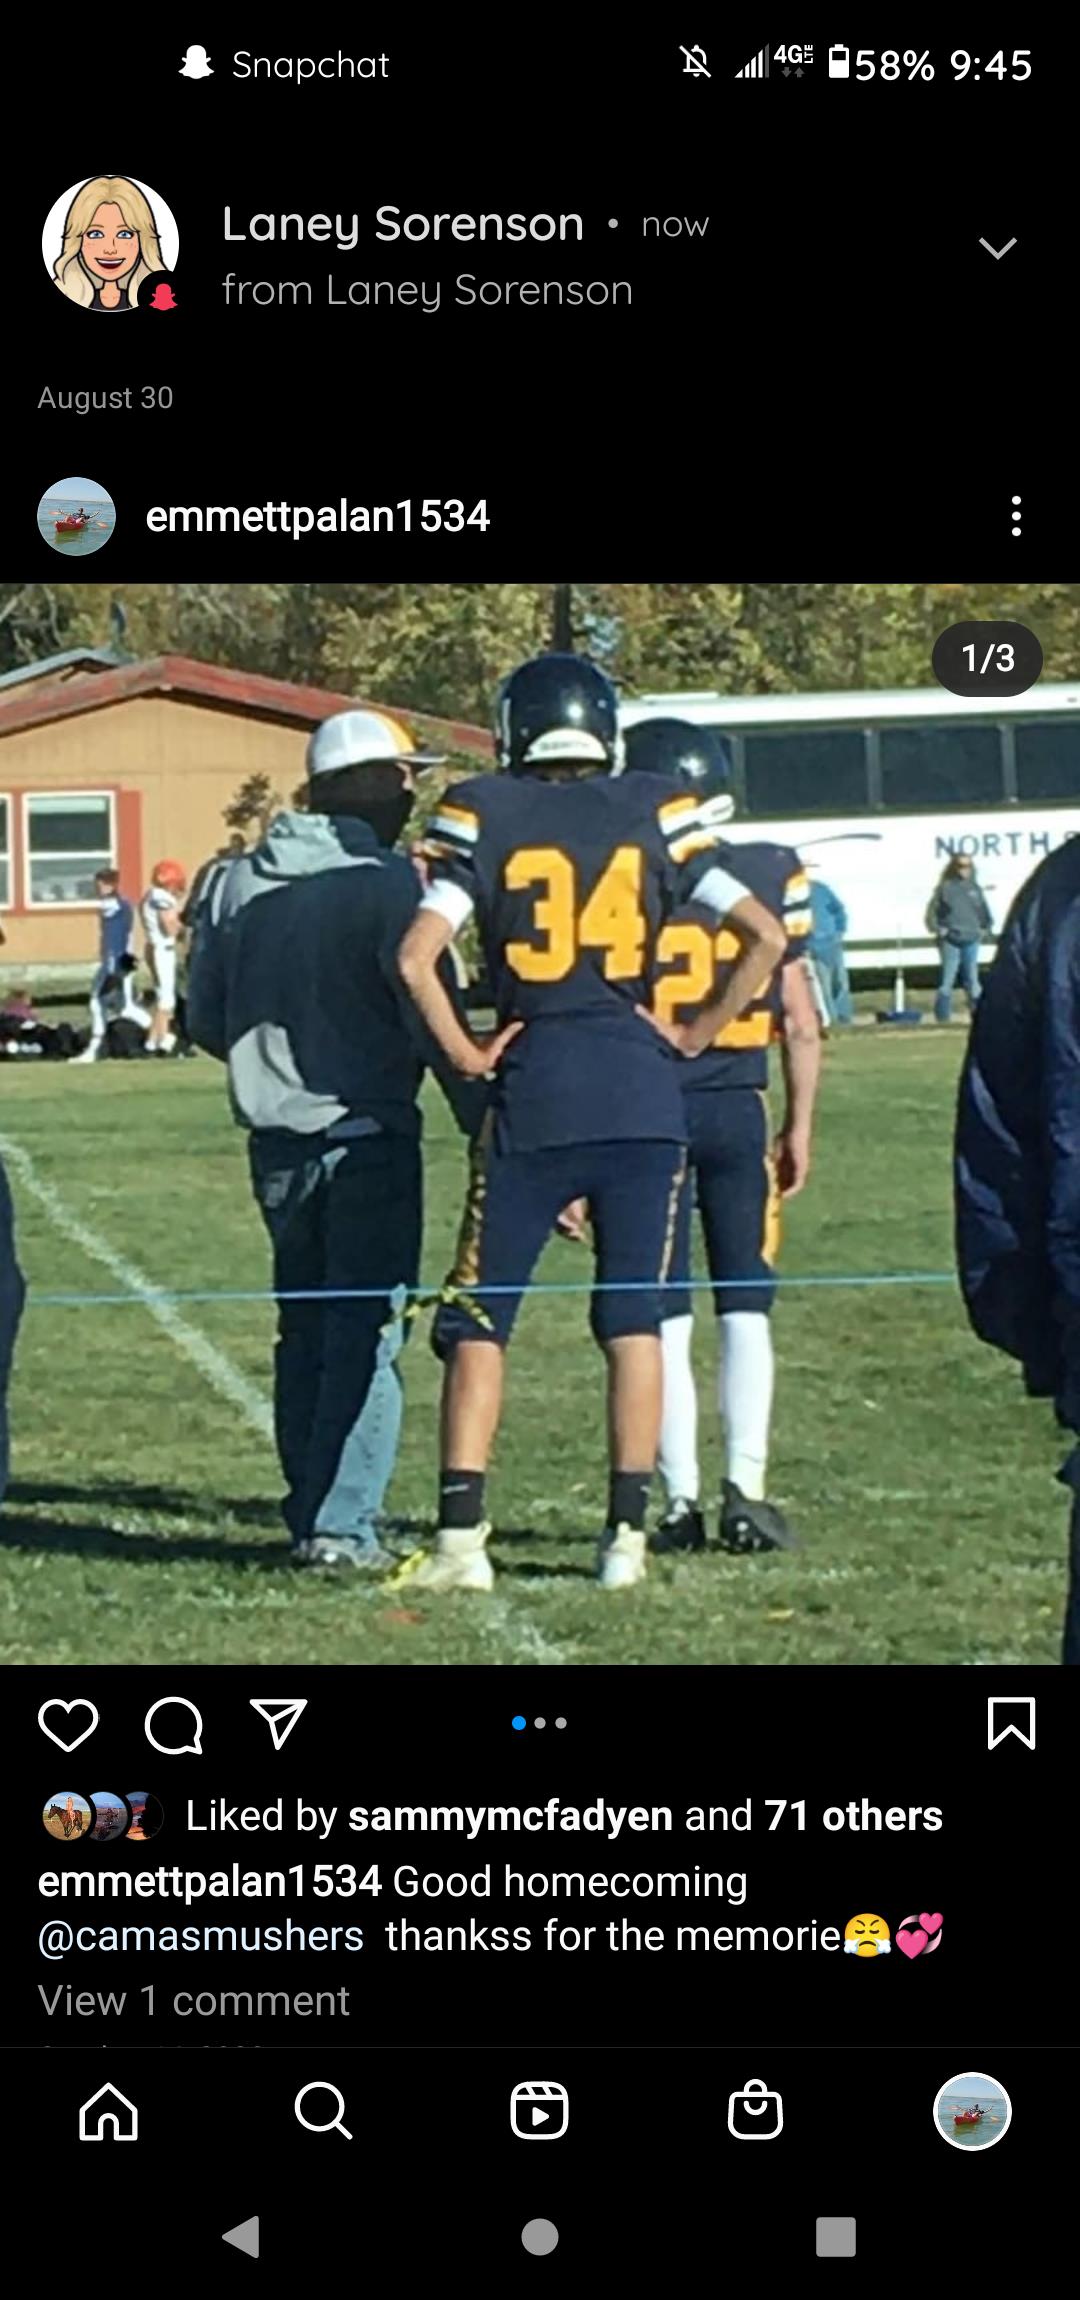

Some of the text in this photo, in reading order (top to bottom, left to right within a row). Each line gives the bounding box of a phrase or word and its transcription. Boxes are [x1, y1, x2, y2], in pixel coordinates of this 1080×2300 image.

[233, 51, 389, 84] Snapchat
[856, 50, 1031, 81] 58% 9:45
[224, 206, 709, 250] Laney Sorenson now
[222, 273, 631, 313] from Laney Sorenson
[38, 386, 172, 414] August 30
[147, 498, 490, 540] emmettpalan1534
[962, 644, 1015, 674] 1/3
[934, 831, 1049, 858] NORTH
[504, 846, 646, 982] 34
[188, 1798, 942, 1839] Liked by sammymcfadyen and 71 others
[39, 1864, 746, 1905] emmettpalan1534 Good homecoming
[39, 1918, 840, 1960] @camasmushers thankss for the memorie
[38, 1985, 350, 2016] View 1 comment
